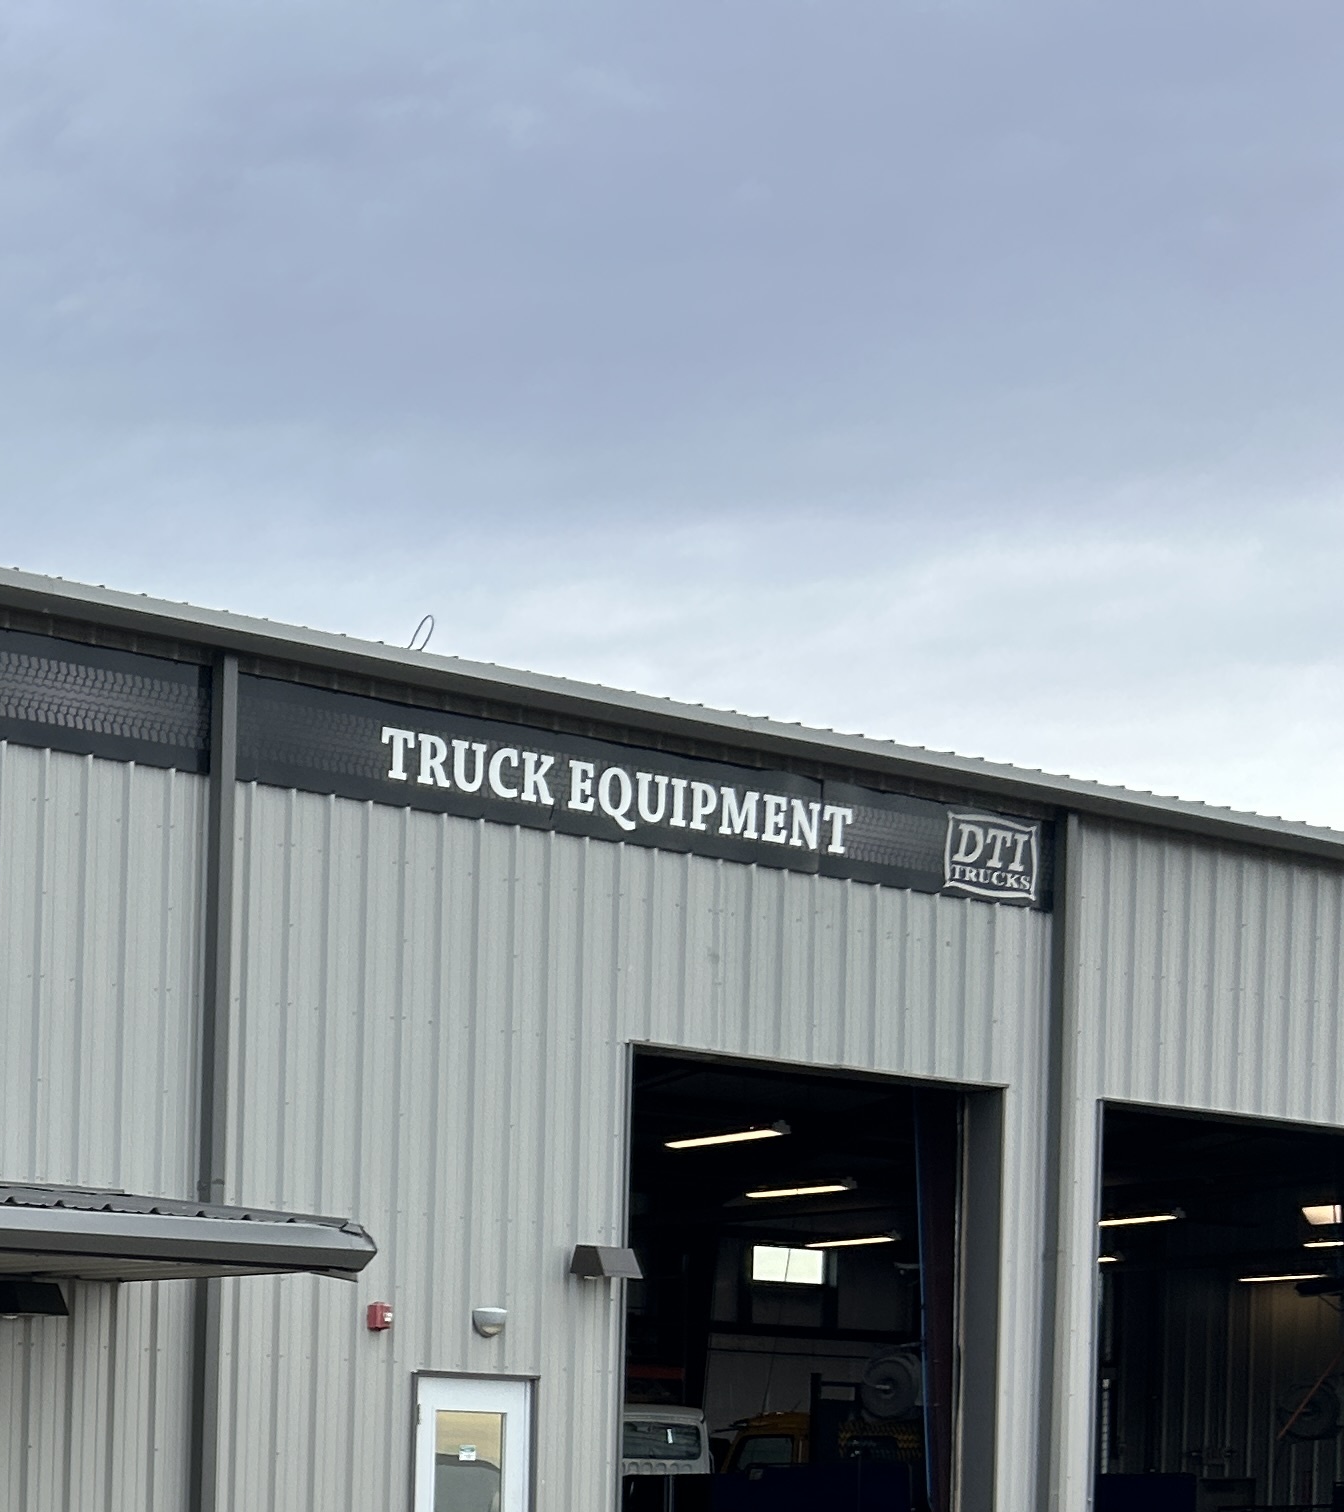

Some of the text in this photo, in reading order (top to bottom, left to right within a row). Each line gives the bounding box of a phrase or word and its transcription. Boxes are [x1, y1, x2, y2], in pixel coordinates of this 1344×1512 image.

[381, 727, 853, 854] TRUCK EQUIPMENT
[952, 823, 1029, 872] DTI
[952, 864, 1031, 890] TRUCKS
